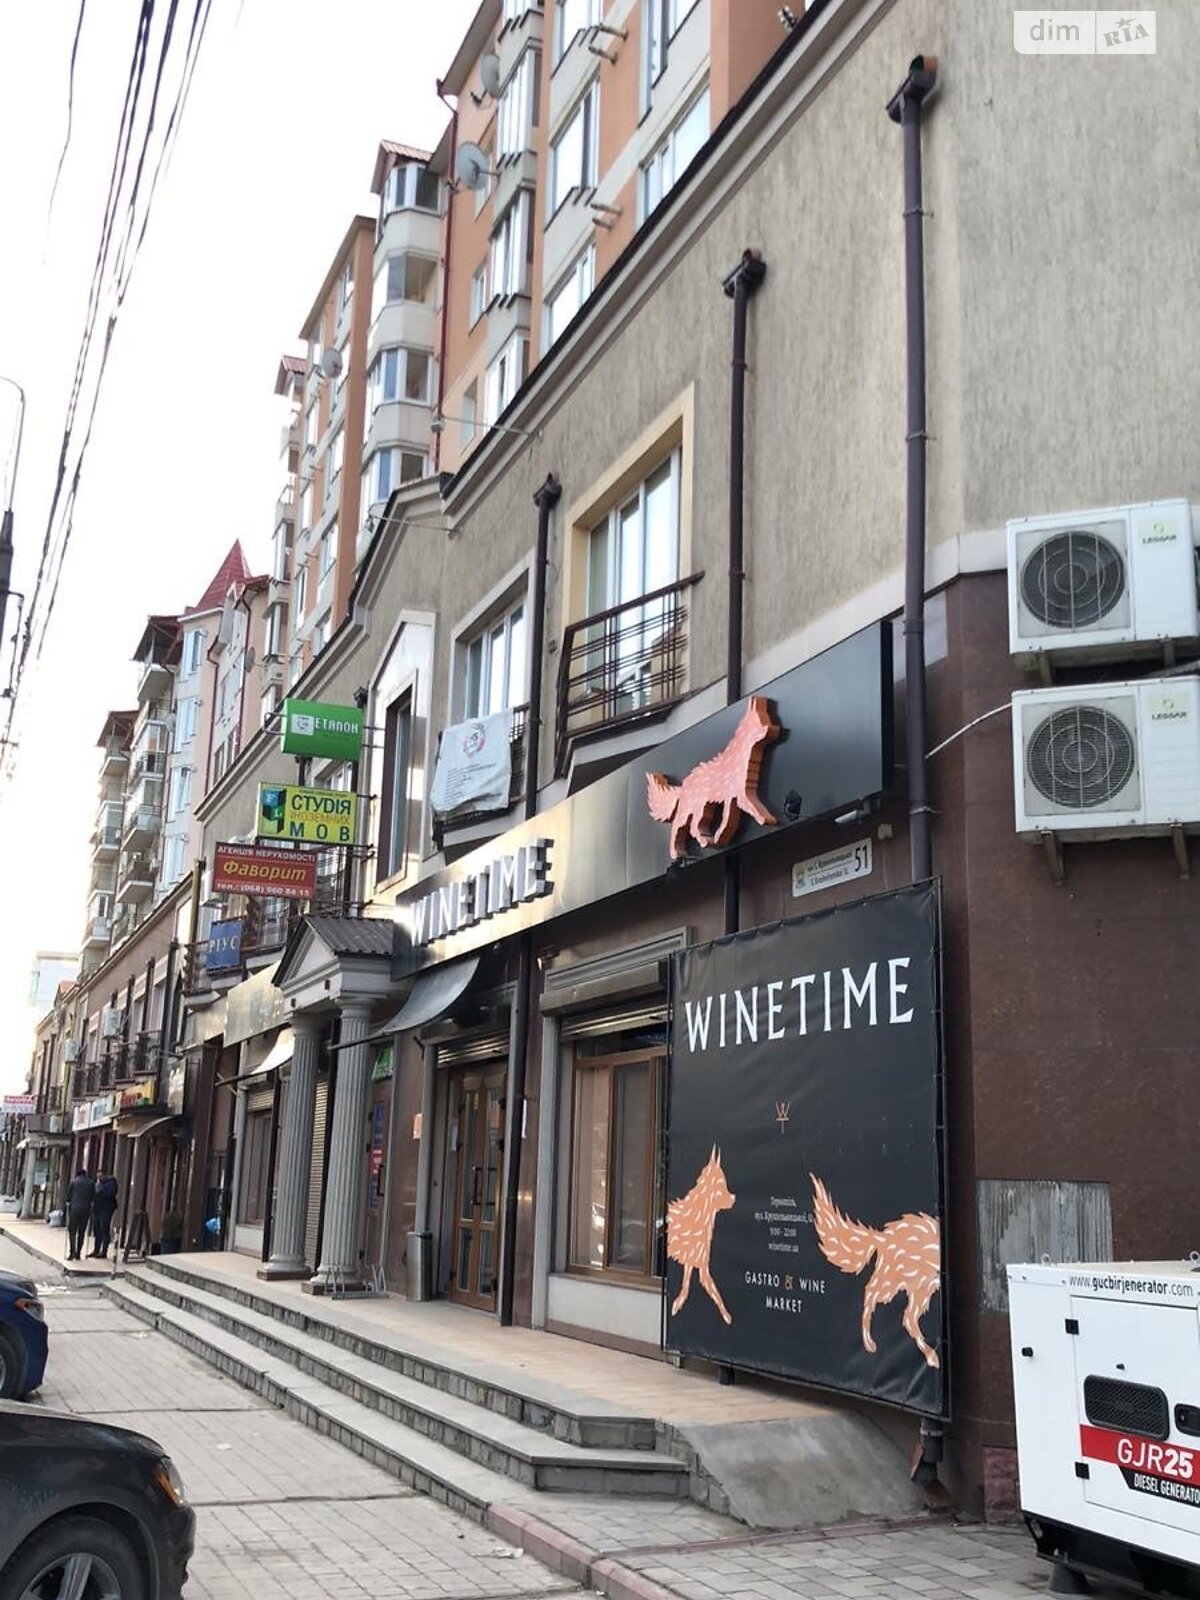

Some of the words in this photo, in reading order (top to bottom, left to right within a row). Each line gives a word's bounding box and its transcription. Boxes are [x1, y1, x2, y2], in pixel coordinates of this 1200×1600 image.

[855, 845, 868, 872] 51
[223, 860, 307, 881] Фаворит
[410, 838, 555, 947] WINETIME
[685, 957, 914, 1053] WINETIME
[745, 1271, 780, 1288] GASTRO
[784, 1274, 794, 1290] &
[800, 1278, 825, 1294] WINE
[1069, 1275, 1193, 1297] www.gucbirjenerator.com
[766, 1296, 802, 1313] MARKET
[1117, 1438, 1194, 1479] GJR25
[1134, 1474, 1159, 1493] DIESEL
